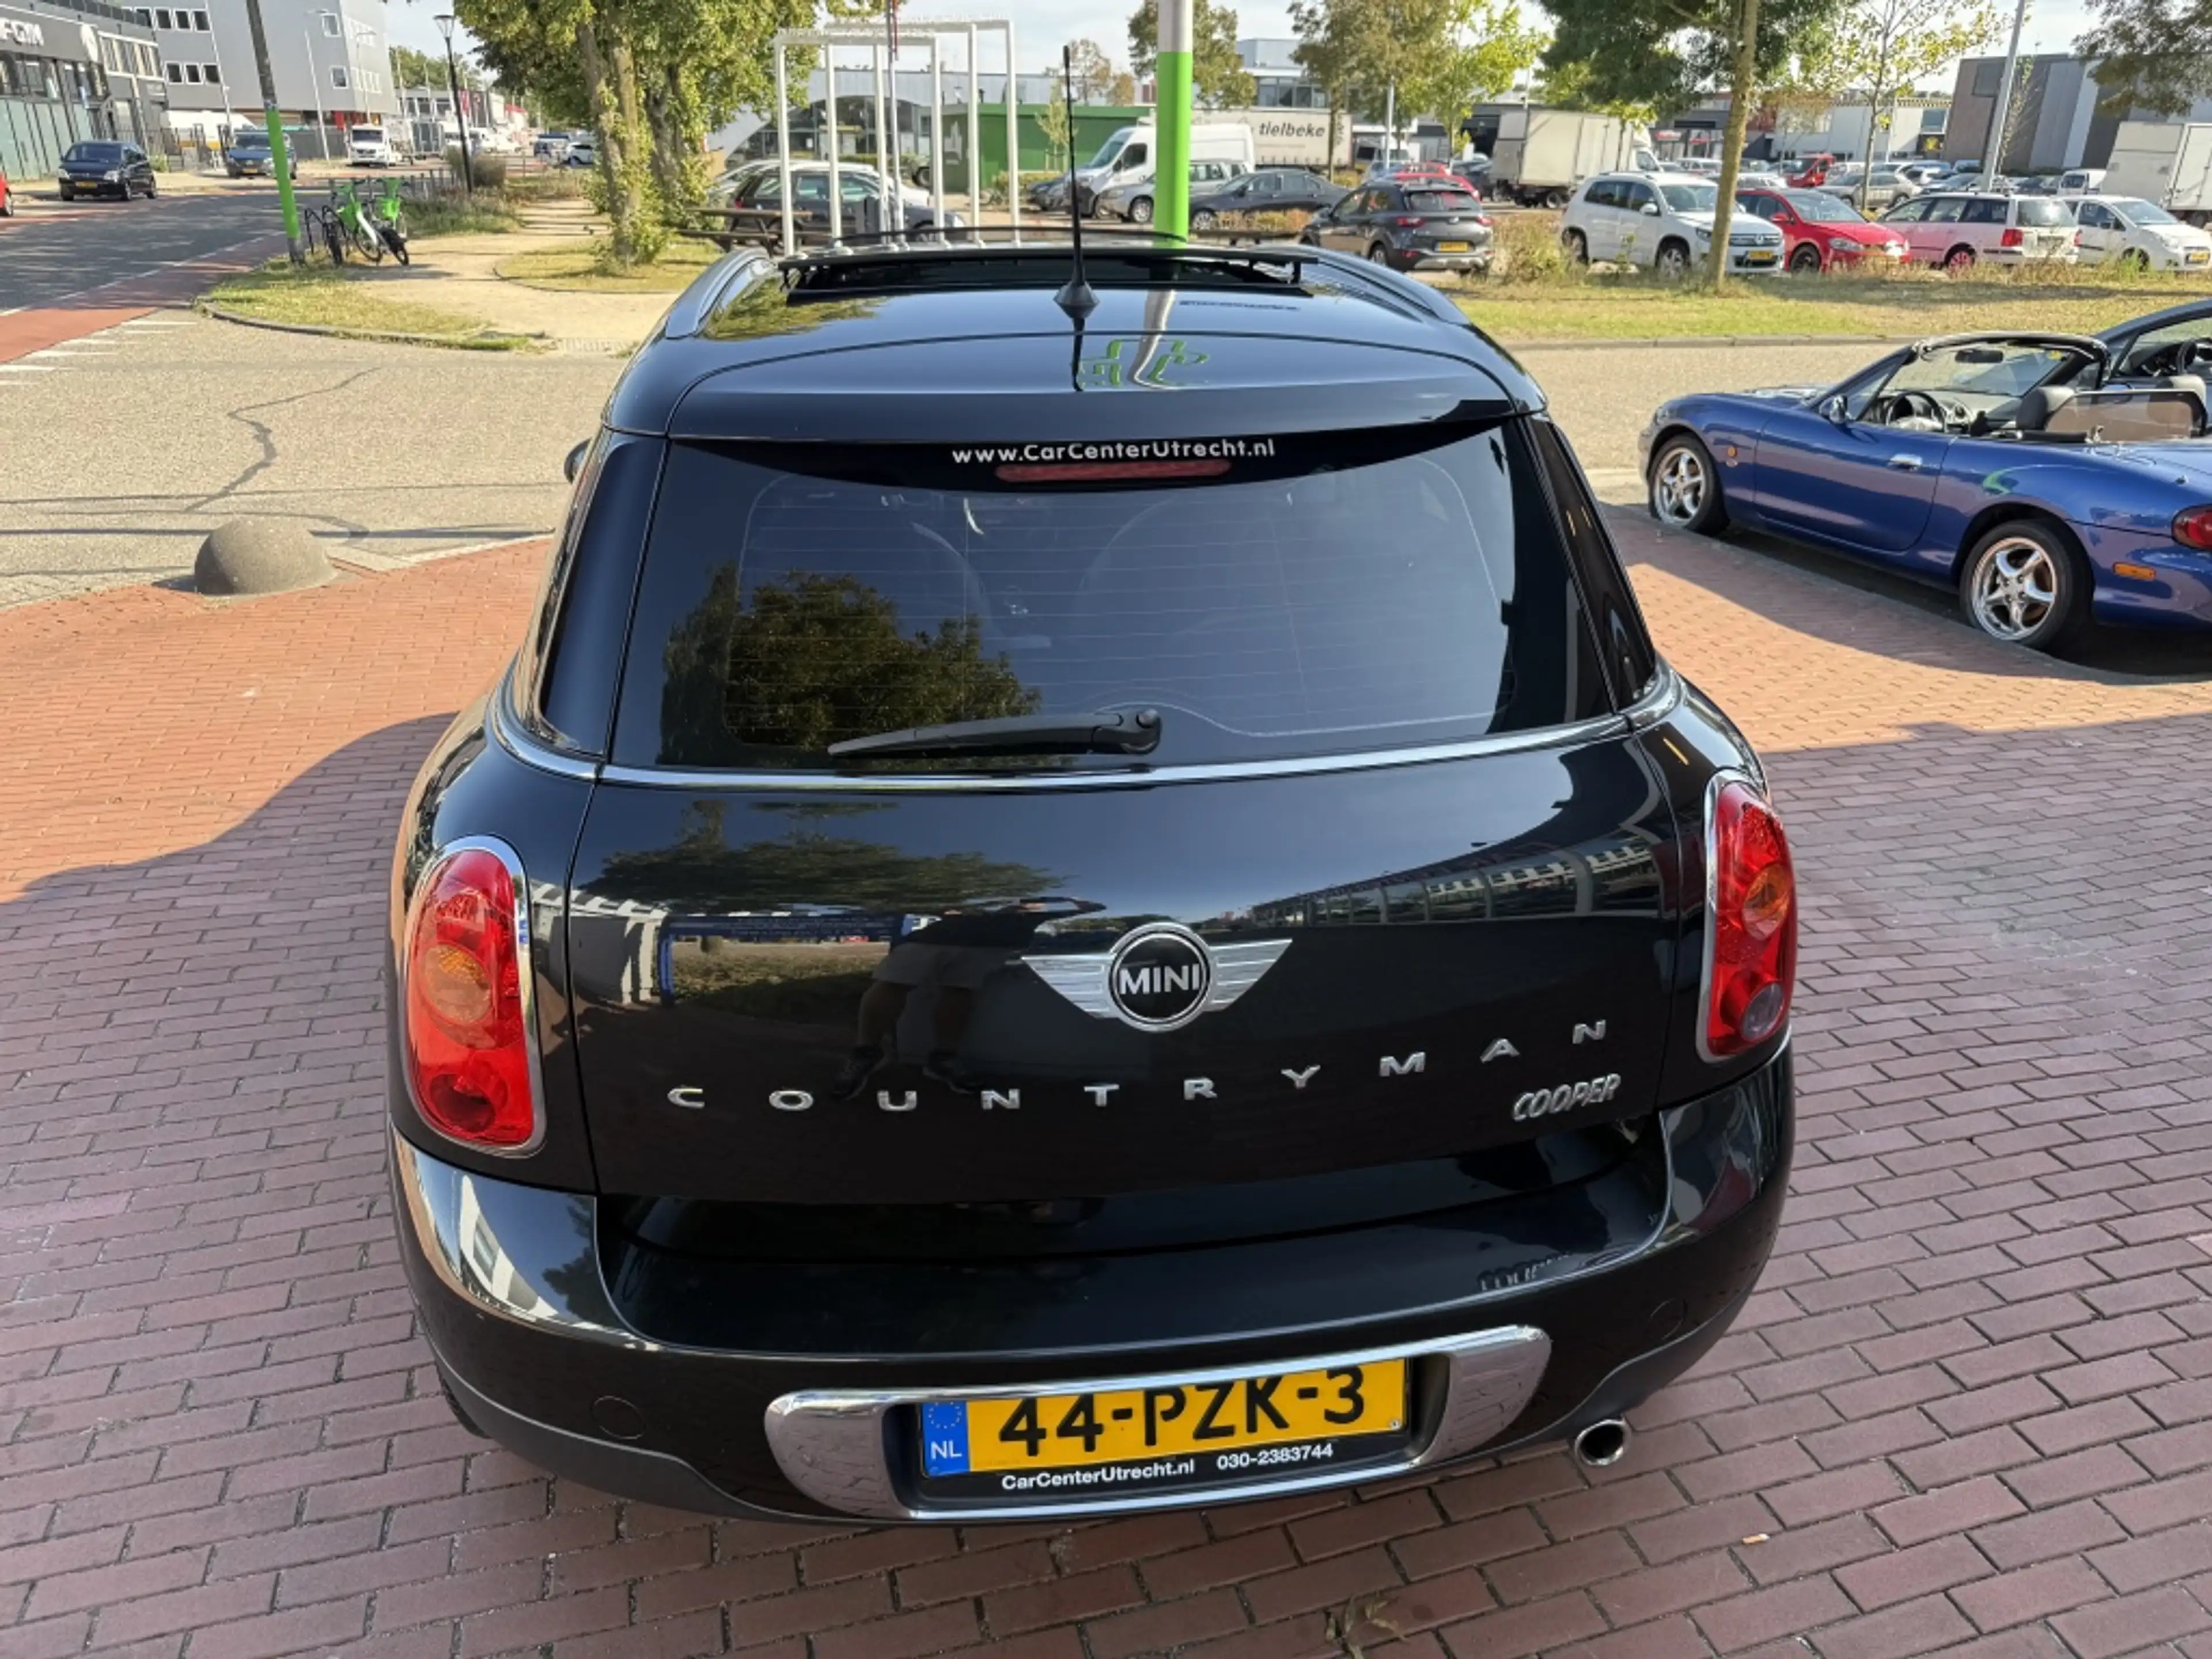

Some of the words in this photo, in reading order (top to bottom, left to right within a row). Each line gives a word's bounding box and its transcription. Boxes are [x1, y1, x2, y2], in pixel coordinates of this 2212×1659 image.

[1259, 121, 1325, 137] tielbeke
[952, 438, 1275, 463] www.CarCenterUtrecht.nl
[1119, 963, 1200, 995] MINI
[1512, 1073, 1622, 1122] COOPER
[998, 1365, 1365, 1457] 44-PZK-3
[930, 1440, 963, 1459] NL
[1001, 1458, 1195, 1490] CarCenterUtrecht.nl
[1217, 1442, 1334, 1471] 030-2383744
